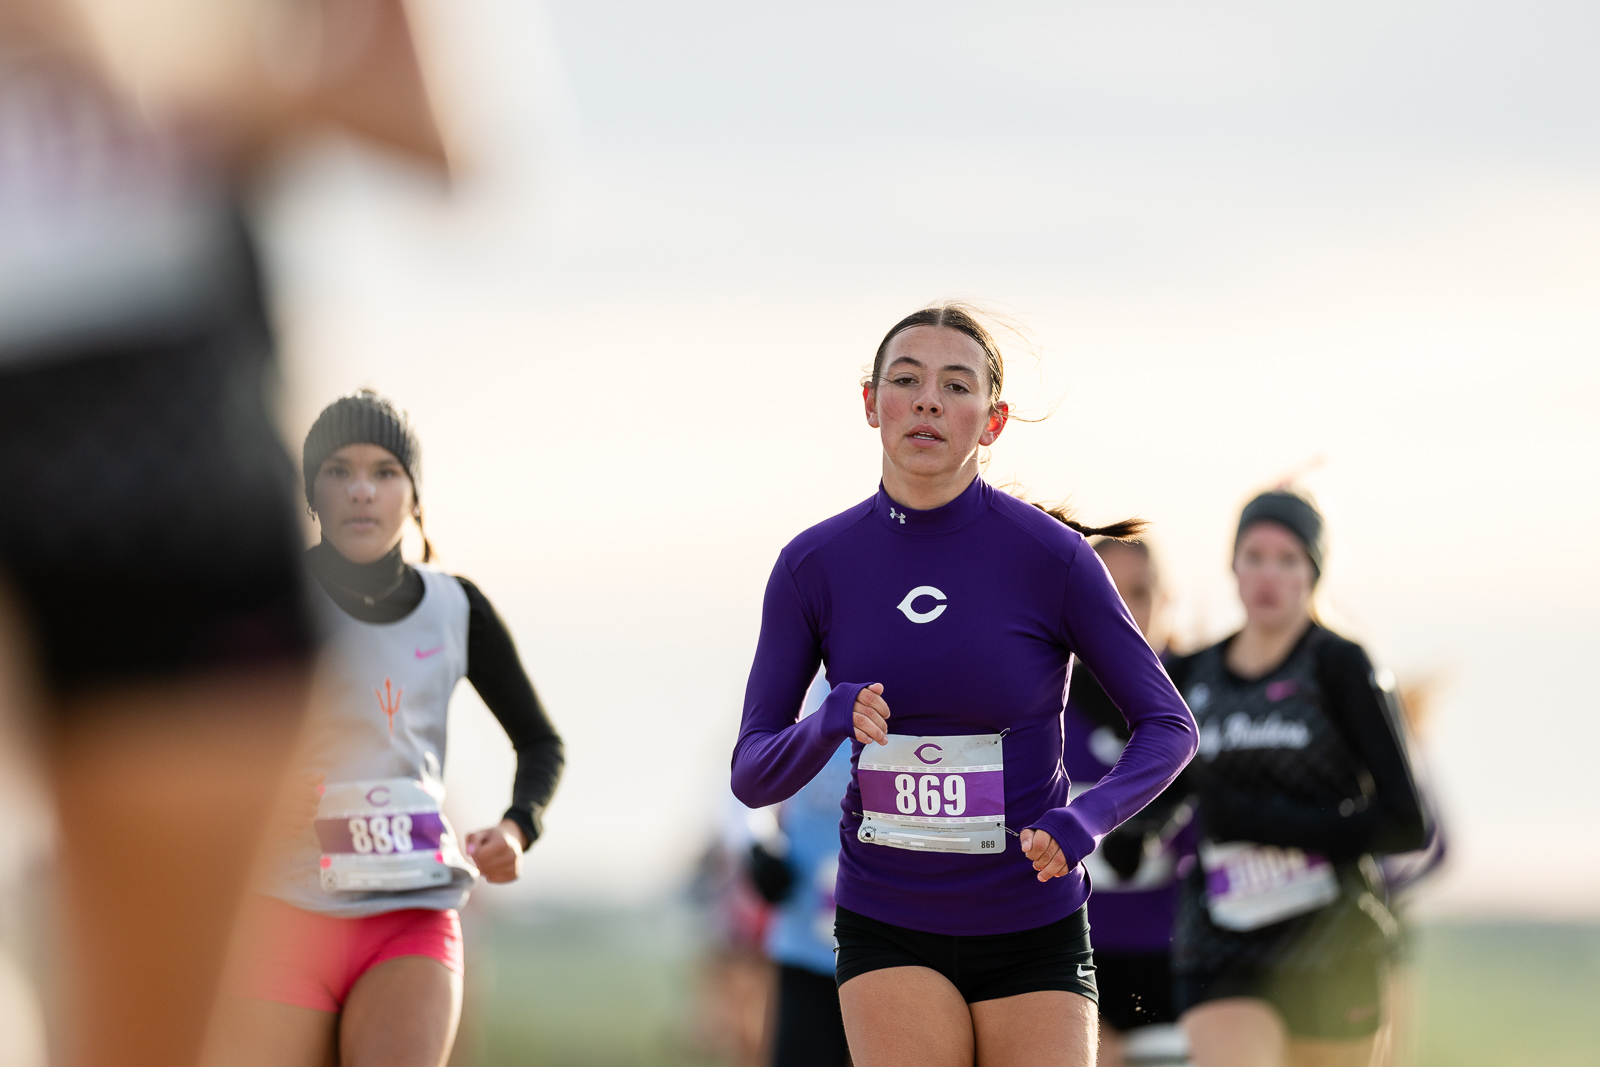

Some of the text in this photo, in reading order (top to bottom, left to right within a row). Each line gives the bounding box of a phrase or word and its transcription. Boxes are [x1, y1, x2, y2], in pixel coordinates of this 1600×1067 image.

[896, 585, 948, 624] C
[913, 743, 943, 765] C
[894, 773, 967, 816] 869
[980, 840, 995, 849] 869
